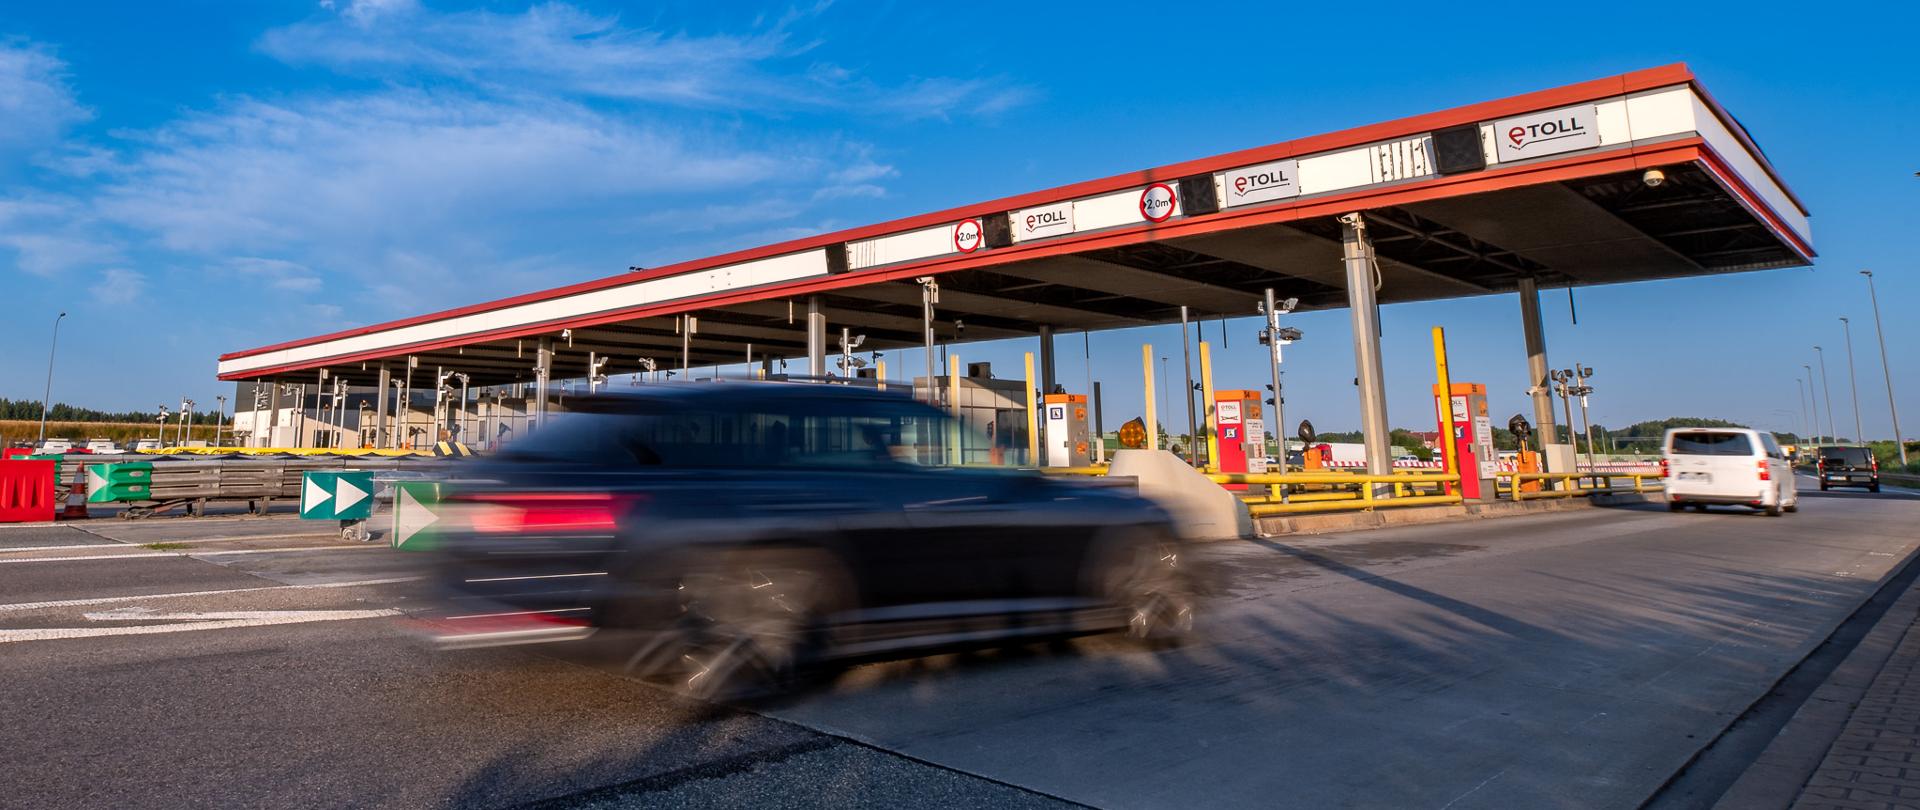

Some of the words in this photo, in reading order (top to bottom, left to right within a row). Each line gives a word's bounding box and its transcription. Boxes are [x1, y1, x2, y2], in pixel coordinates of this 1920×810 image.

[1509, 117, 1584, 146] eTOLL
[1235, 171, 1288, 193] eTOLL
[1026, 211, 1066, 229] eTOLL
